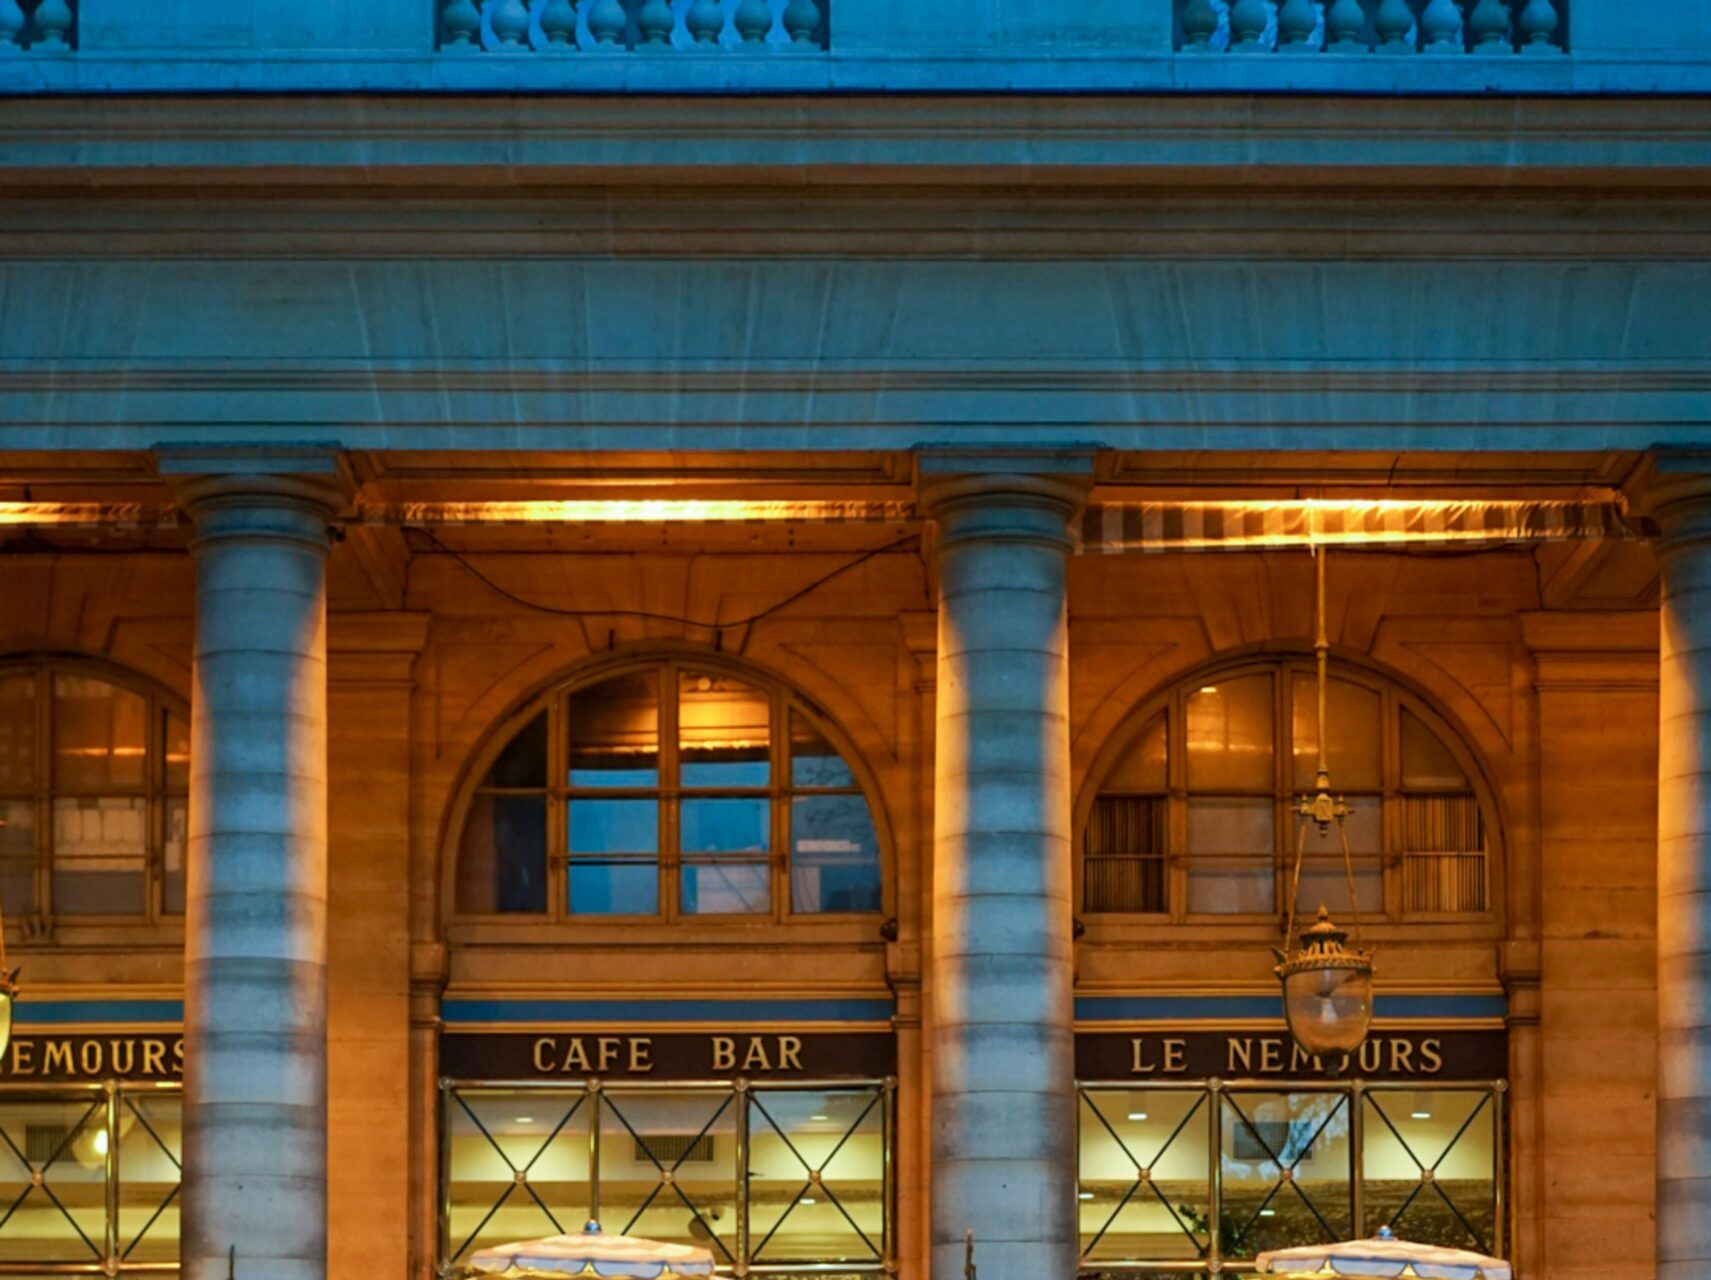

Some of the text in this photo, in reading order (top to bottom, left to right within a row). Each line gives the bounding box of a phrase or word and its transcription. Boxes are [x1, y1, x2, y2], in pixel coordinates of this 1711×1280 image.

[0, 1040, 184, 1075] EMOURS
[533, 1036, 804, 1072] CAFE BAR
[1131, 1038, 1443, 1073] LE NEMURS
